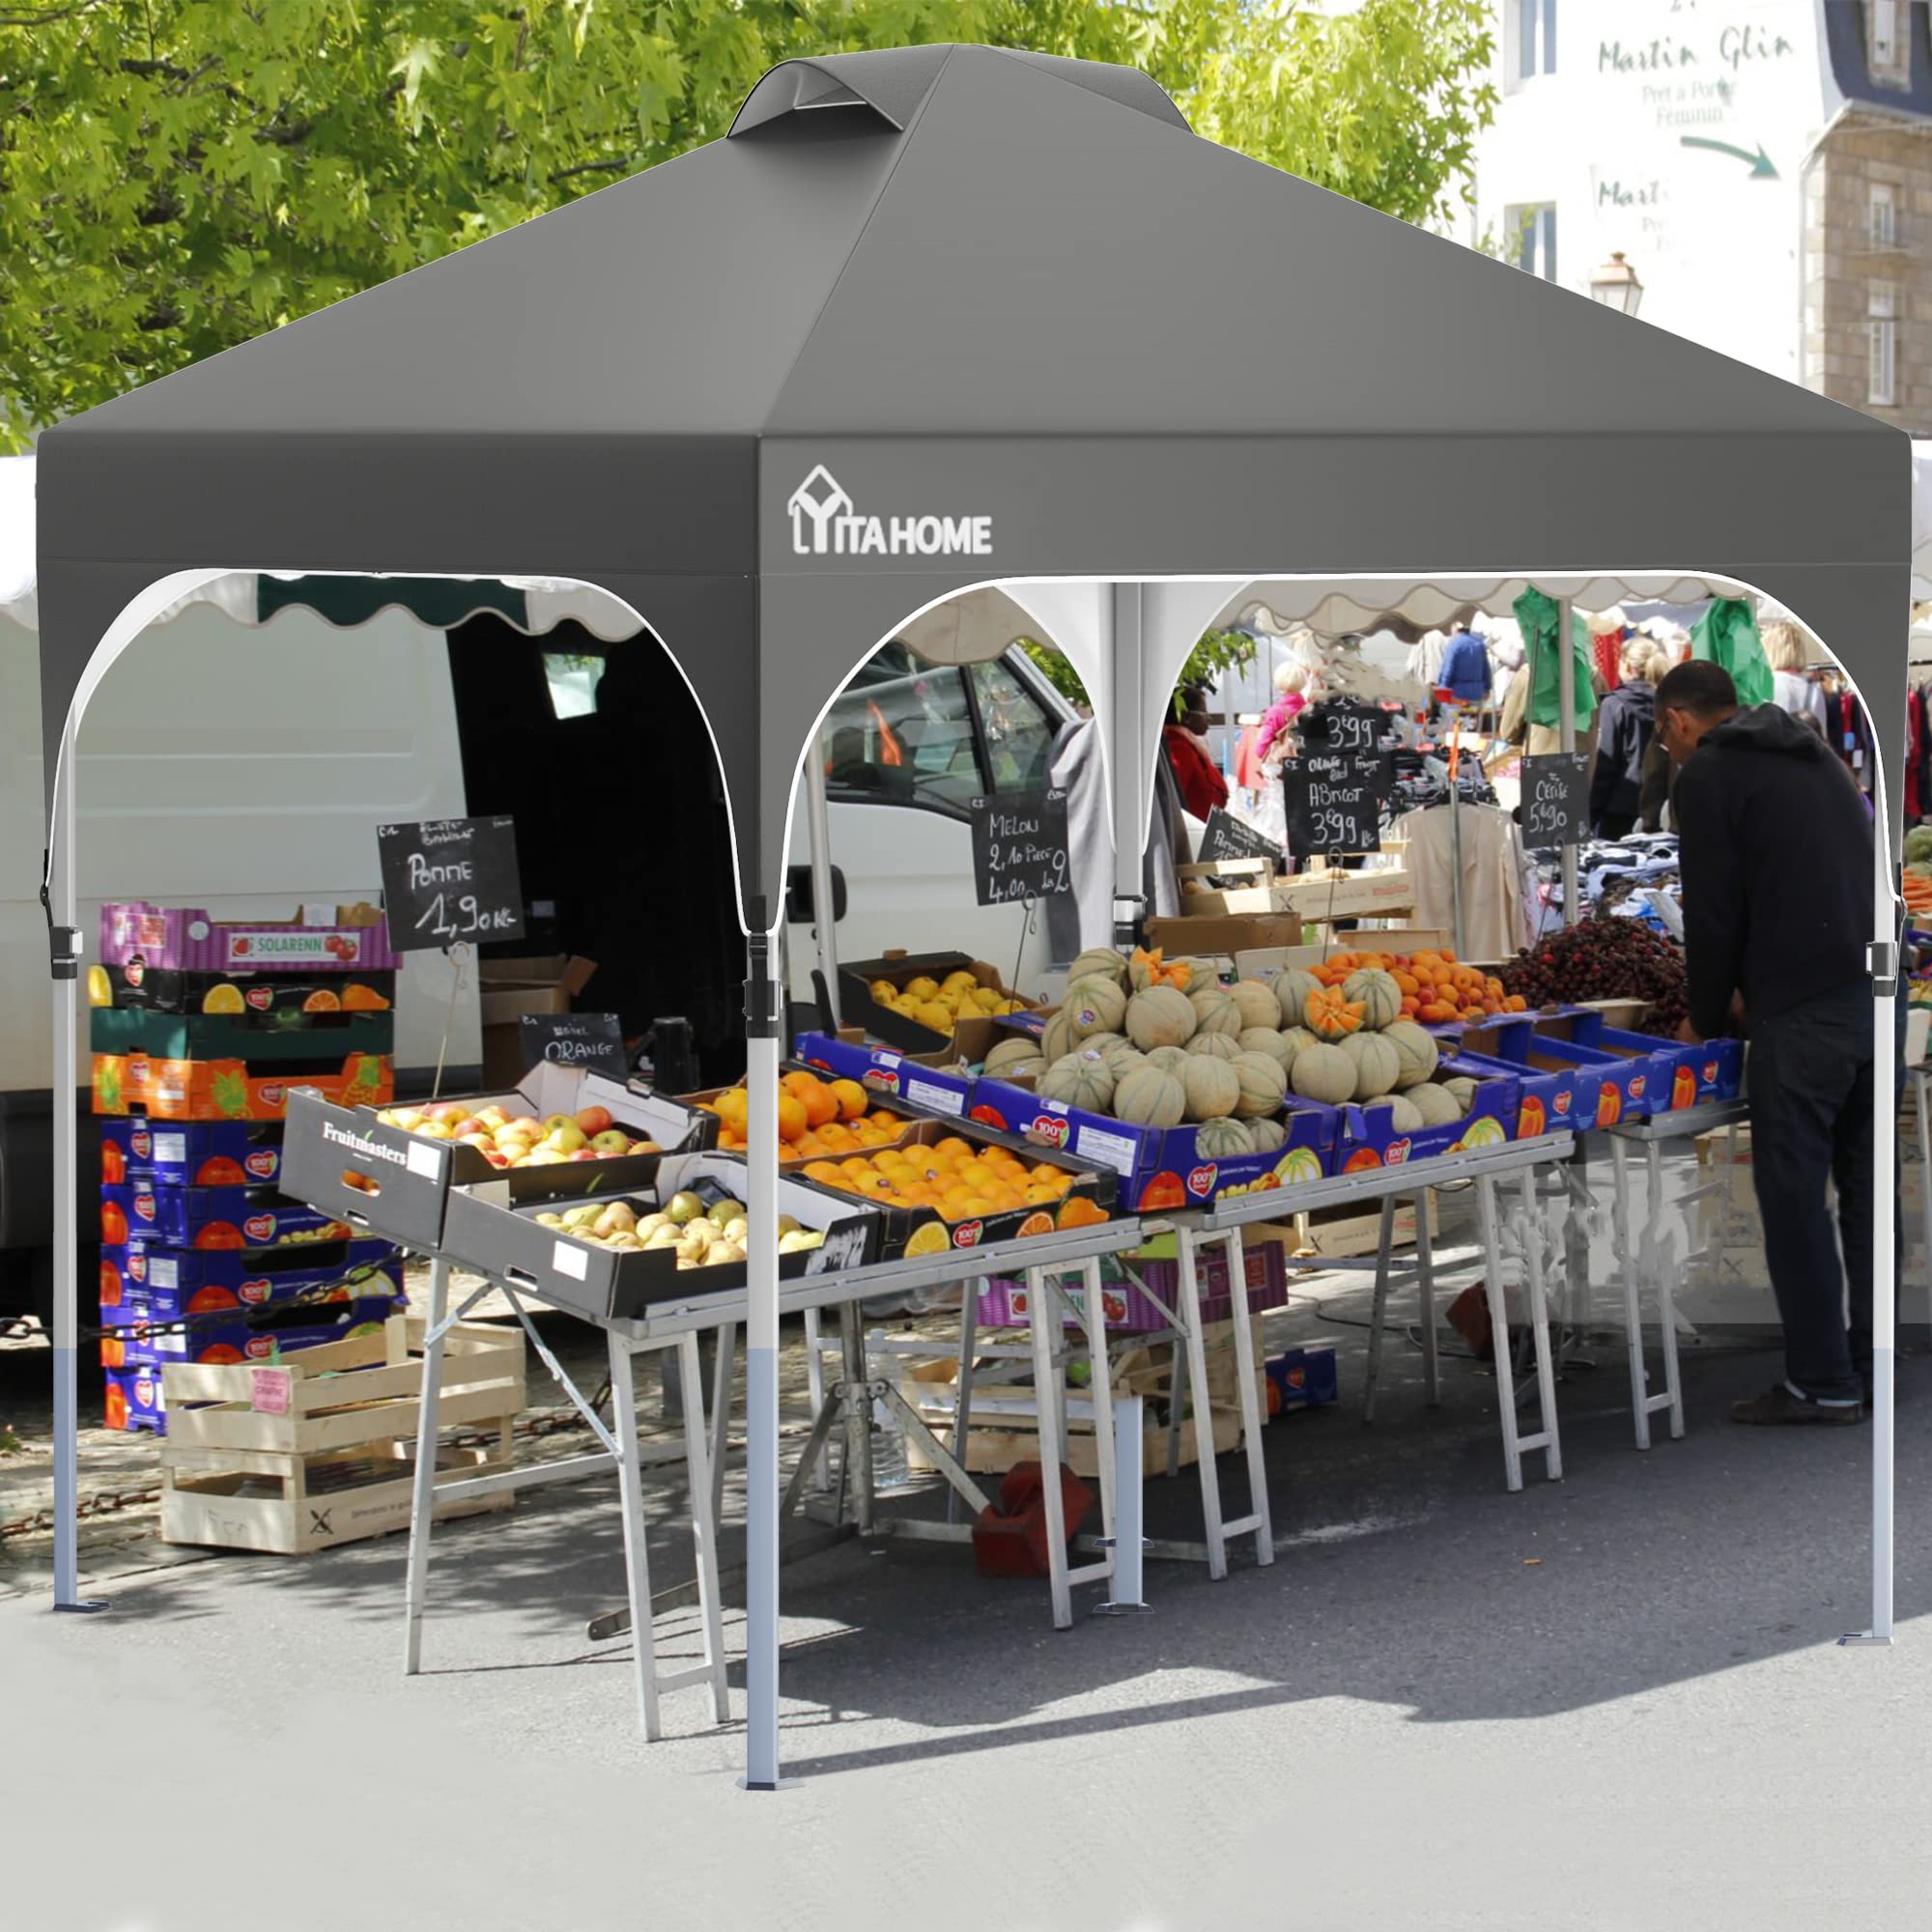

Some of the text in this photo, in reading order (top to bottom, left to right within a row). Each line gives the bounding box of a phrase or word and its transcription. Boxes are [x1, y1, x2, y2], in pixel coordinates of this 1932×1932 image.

[1599, 36, 1696, 73] Martin
[989, 812, 1039, 838] MELON
[257, 937, 322, 952] SOLARENN
[545, 1040, 614, 1061] ORANGE
[324, 1121, 407, 1166] Fruitmasters
